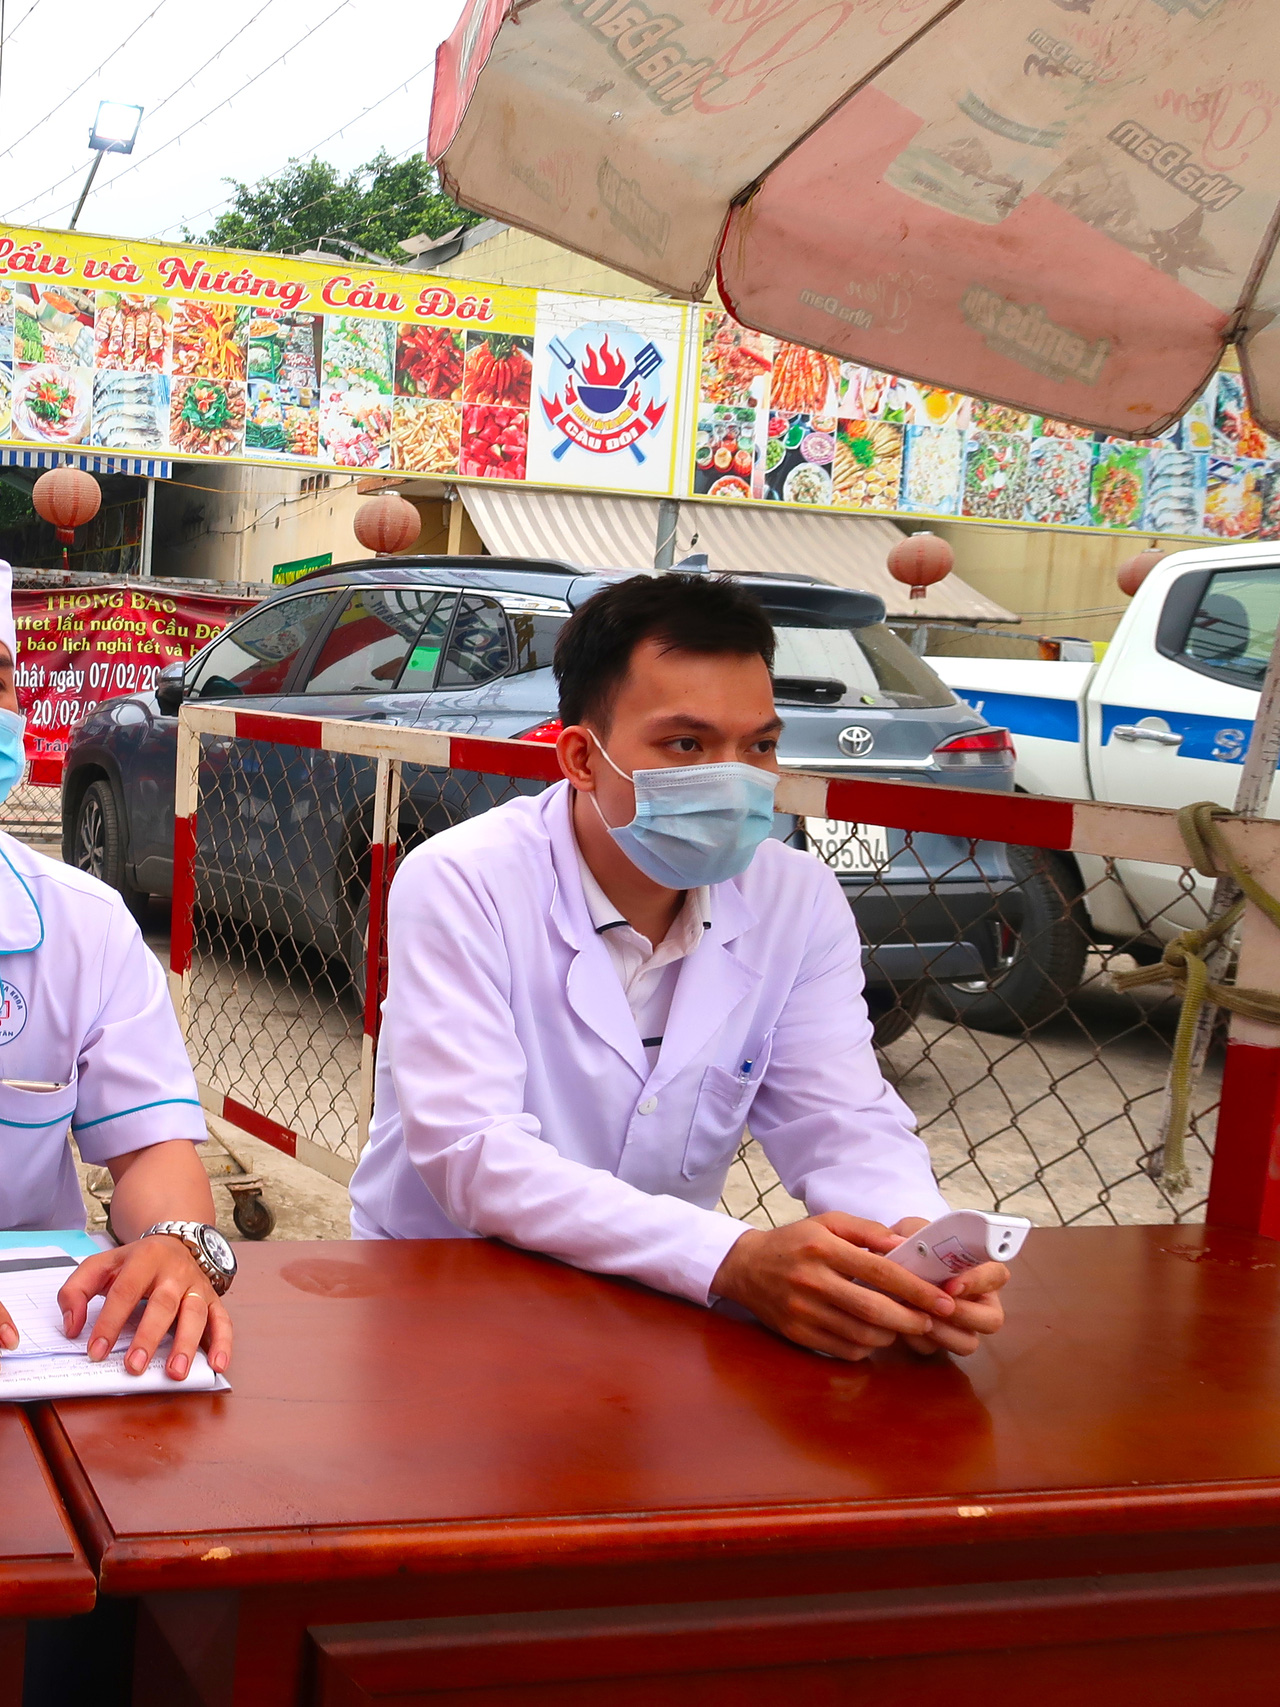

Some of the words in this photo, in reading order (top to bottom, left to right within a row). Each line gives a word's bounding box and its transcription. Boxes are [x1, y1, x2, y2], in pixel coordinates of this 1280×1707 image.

[83, 255, 143, 284] và
[157, 256, 311, 311] Nướng
[322, 275, 407, 313] Cầu
[416, 286, 496, 323] Đôi
[15, 616, 51, 631] ffet
[57, 613, 84, 631] lẩu
[91, 616, 146, 636] nướng
[152, 618, 188, 637] Cầu
[27, 637, 57, 651] báo
[62, 637, 90, 654] lịch
[97, 637, 132, 654] nghỉ
[137, 638, 161, 654] tết
[165, 644, 183, 657] và
[48, 663, 84, 693] ngày
[89, 662, 160, 693] 07/02/20
[811, 838, 886, 869] 785.04
